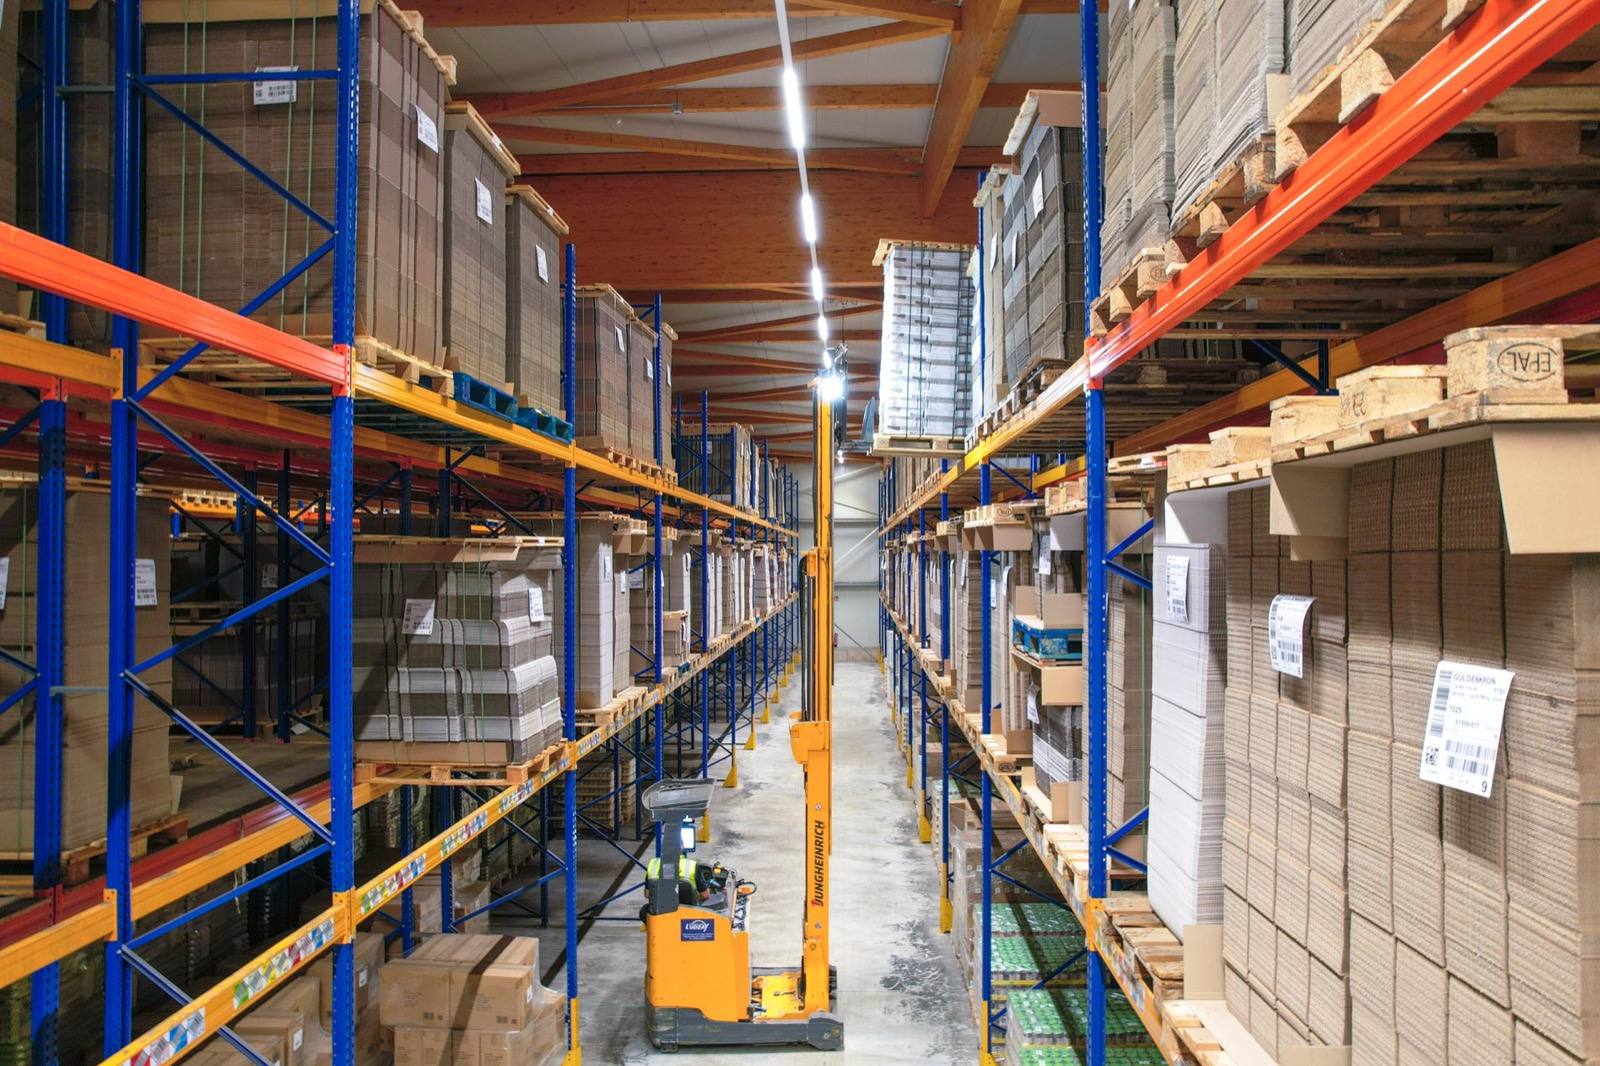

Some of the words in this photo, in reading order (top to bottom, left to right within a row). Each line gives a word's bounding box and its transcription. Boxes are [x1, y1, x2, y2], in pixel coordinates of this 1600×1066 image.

[1507, 352, 1551, 373] EPAL
[1453, 673, 1496, 685] GULDENKRON
[1481, 780, 1488, 793] 9
[813, 820, 825, 907] JUNGHEINRICH
